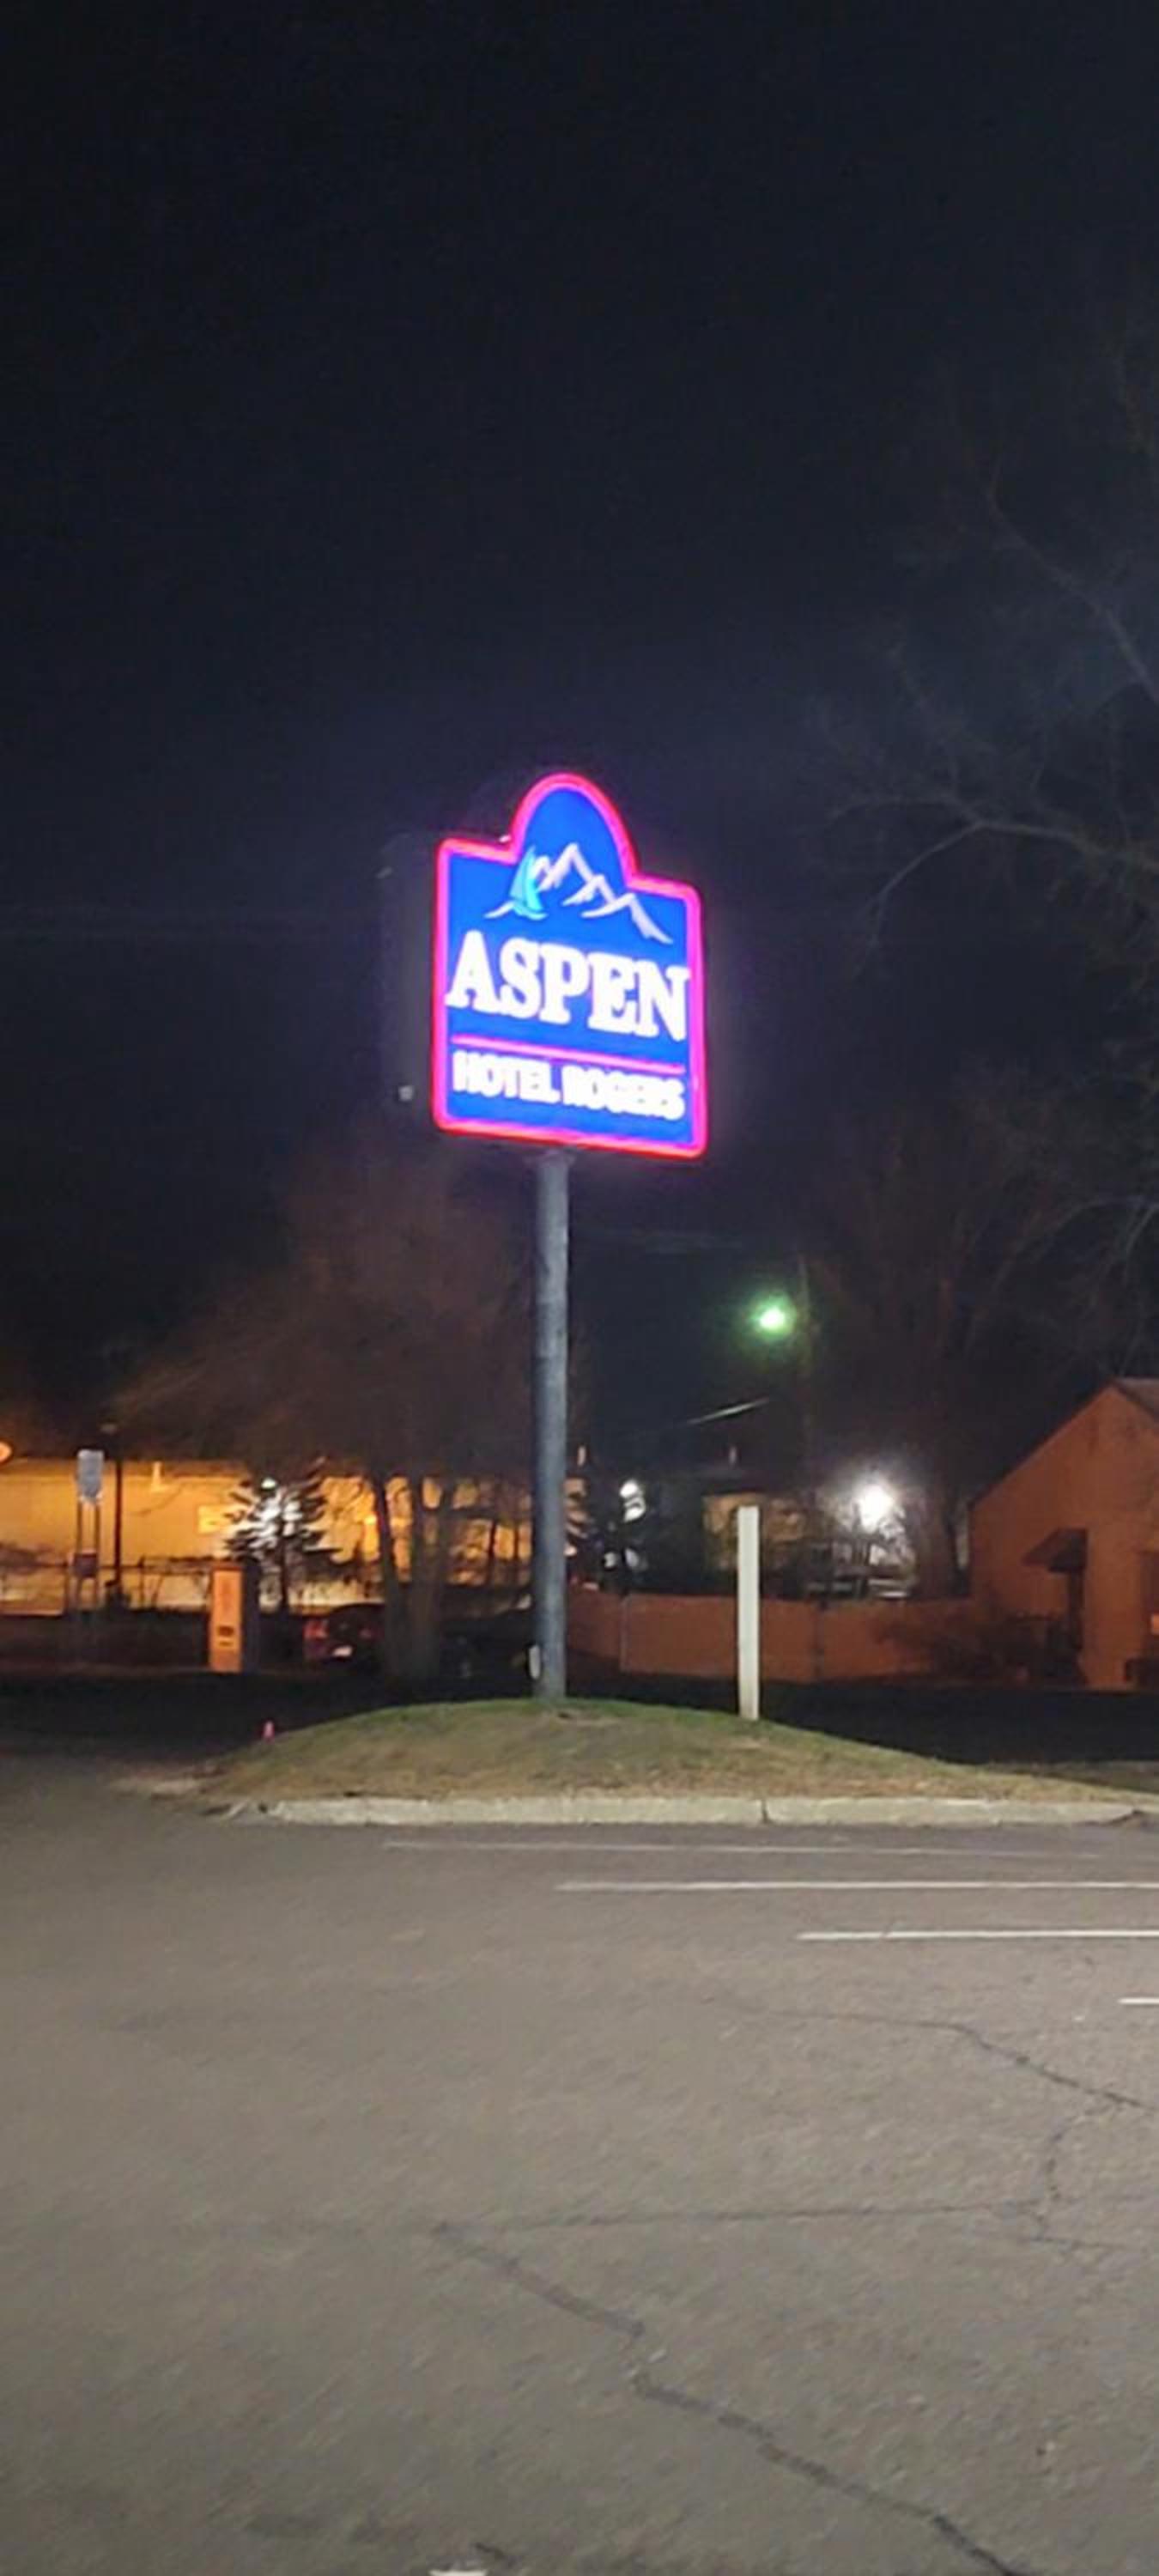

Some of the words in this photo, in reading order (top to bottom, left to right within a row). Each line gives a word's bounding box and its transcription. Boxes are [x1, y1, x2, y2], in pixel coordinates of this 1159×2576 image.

[446, 930, 689, 1041] ASPEN
[452, 1051, 560, 1103] HOTEL
[562, 1065, 684, 1120] ROGERS
